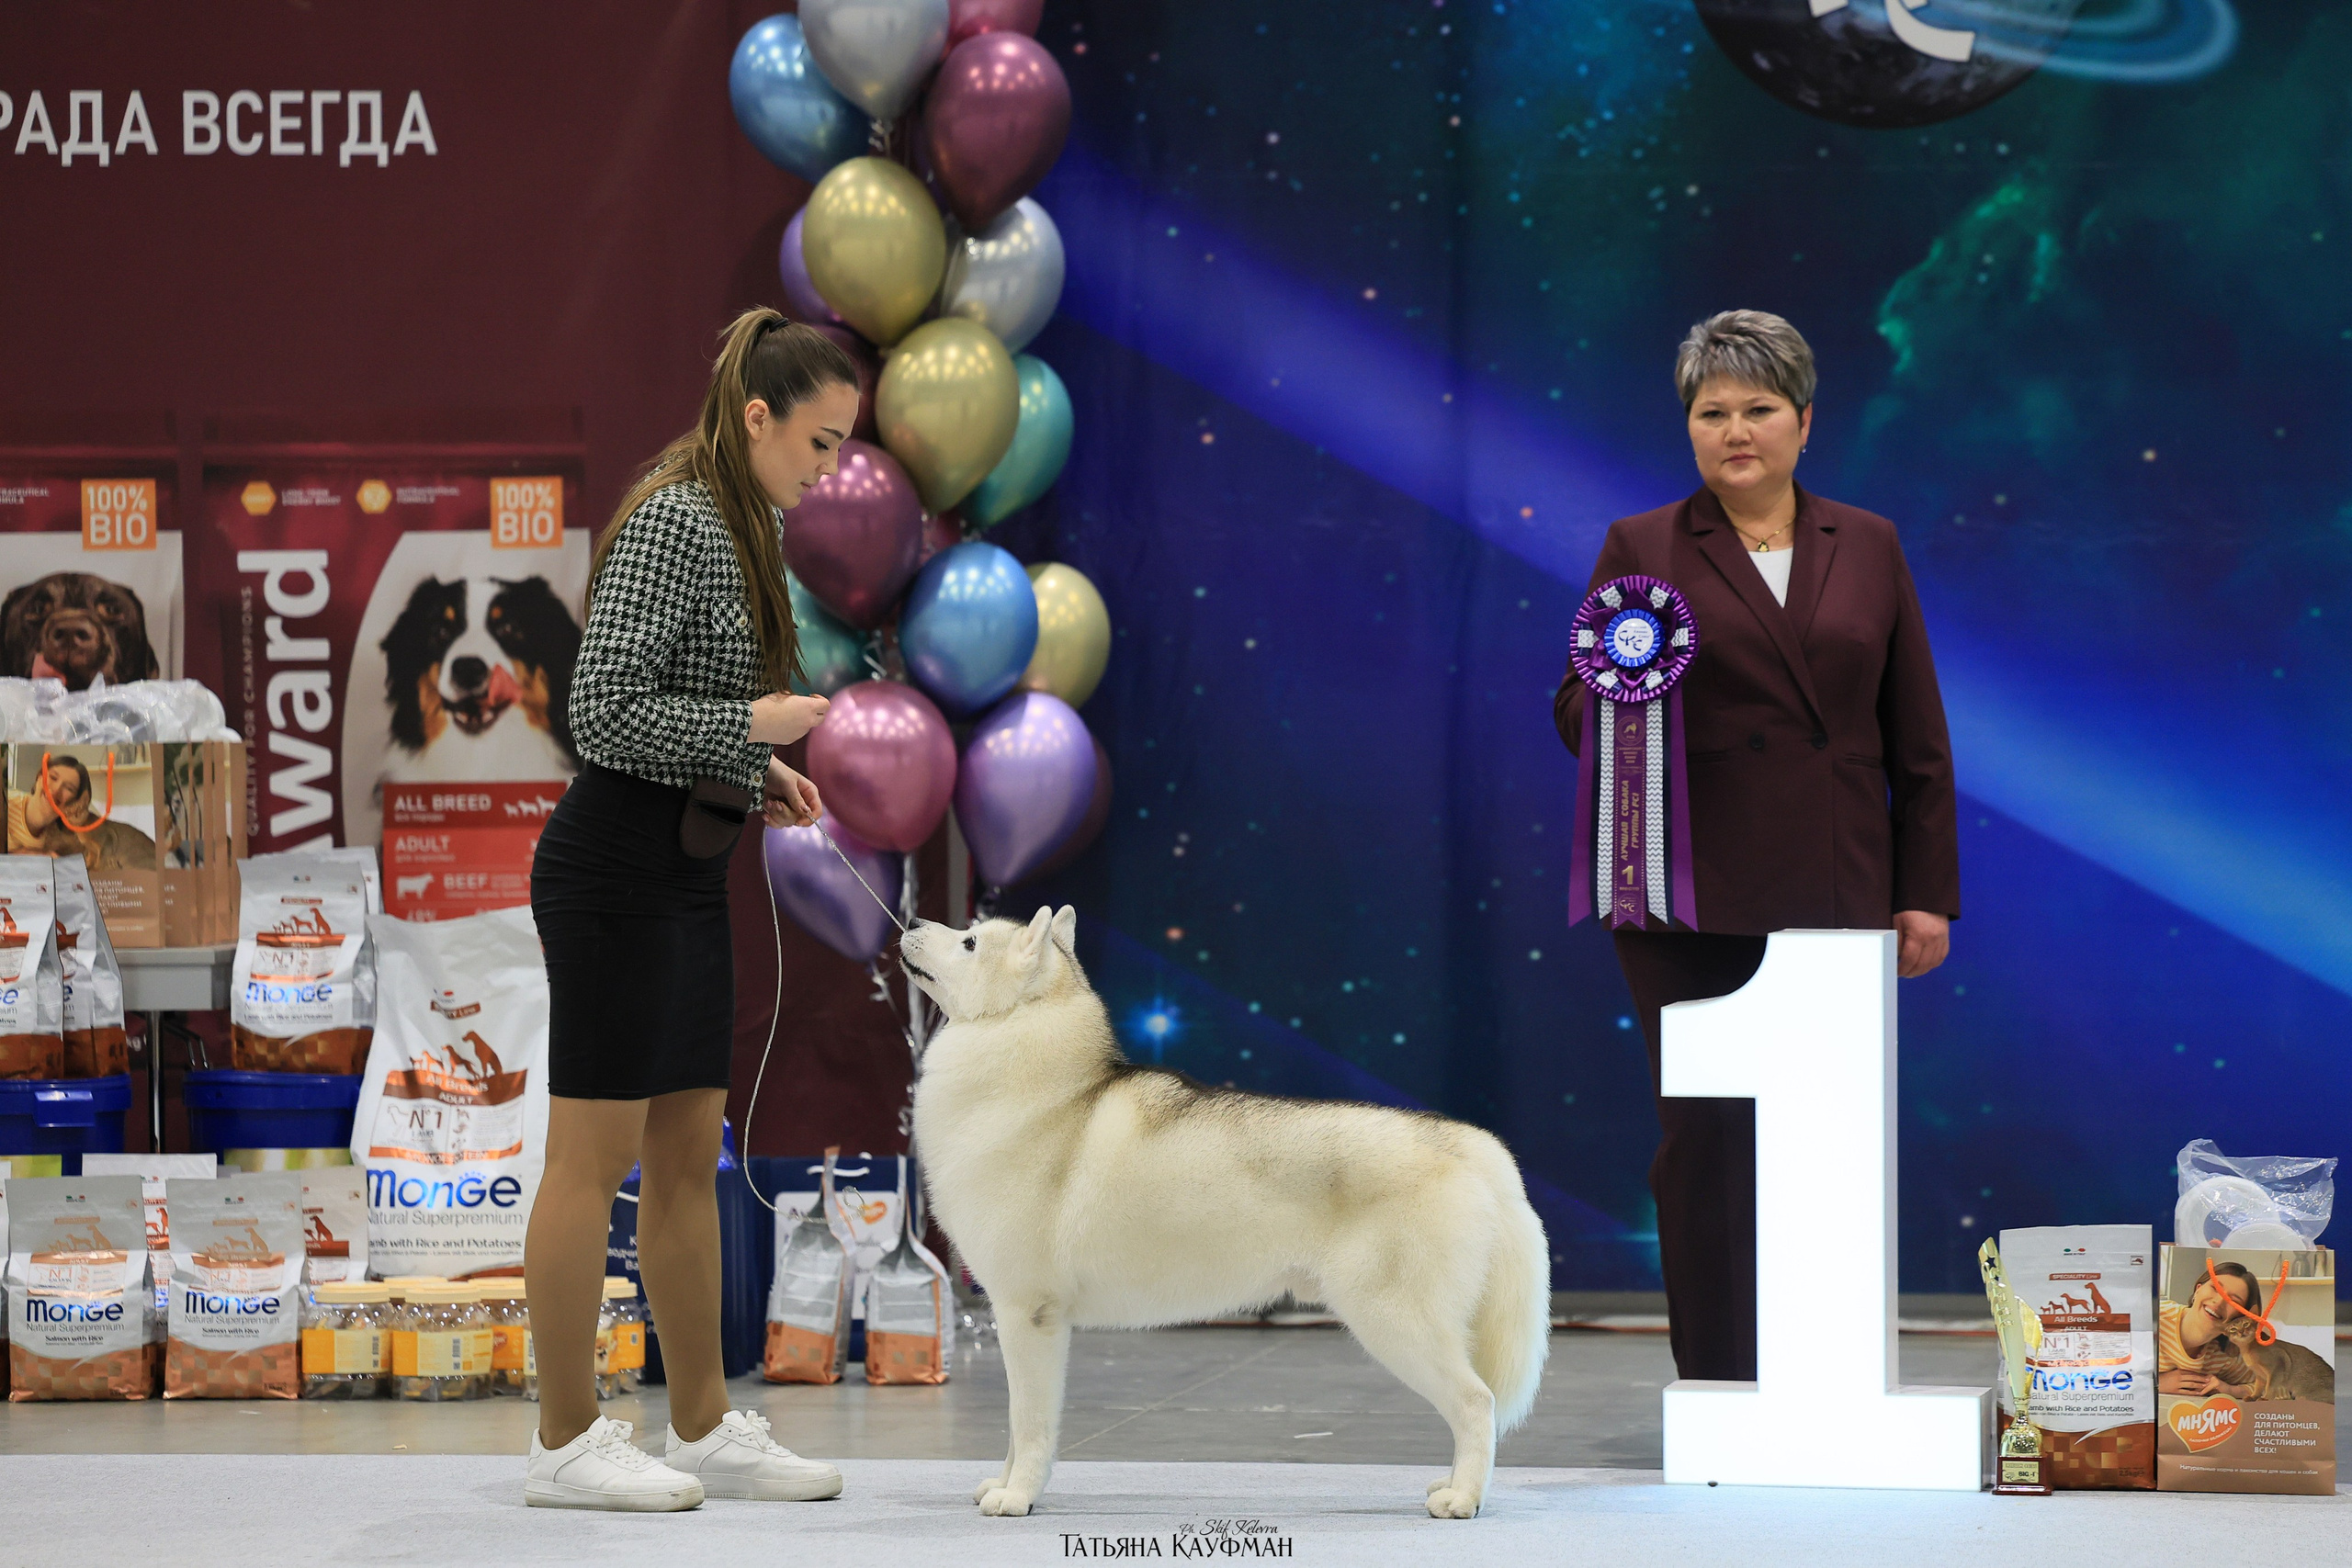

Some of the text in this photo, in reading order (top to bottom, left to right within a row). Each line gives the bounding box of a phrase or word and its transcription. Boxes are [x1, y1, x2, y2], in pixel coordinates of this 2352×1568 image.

[183, 90, 437, 167] ВСЕГДА
[87, 485, 147, 512] 100%
[495, 483, 555, 510] 100%
[90, 513, 147, 545] BIO
[498, 512, 552, 543] BIO
[241, 585, 255, 704] CHAMPIONS
[243, 709, 256, 748] FOR
[394, 794, 492, 812] ALL BREED
[1621, 780, 1629, 861] ЛУЧШАЯ СОБАКА
[395, 835, 451, 852] ADULT
[444, 874, 488, 889] BEEF
[1622, 865, 1634, 885] 1
[438, 1091, 474, 1105] ADULT
[413, 1210, 523, 1228] Superpremium
[1661, 929, 1987, 1492] 1
[368, 1237, 522, 1248] amb with Rice and Potatoes
[27, 1323, 125, 1333] Natural Superpremium
[184, 1314, 280, 1325] Natural Superpremium
[2061, 1392, 2134, 1403] Superpremium
[2254, 1413, 2295, 1421] СОЗДАНЫ
[2254, 1421, 2321, 1430] ДЛЯ ПИТОМЦЕВ,
[2254, 1438, 2316, 1447] СЧАСТЛИВЫМИ
[2254, 1446, 2277, 1454] ВСЕХ!
